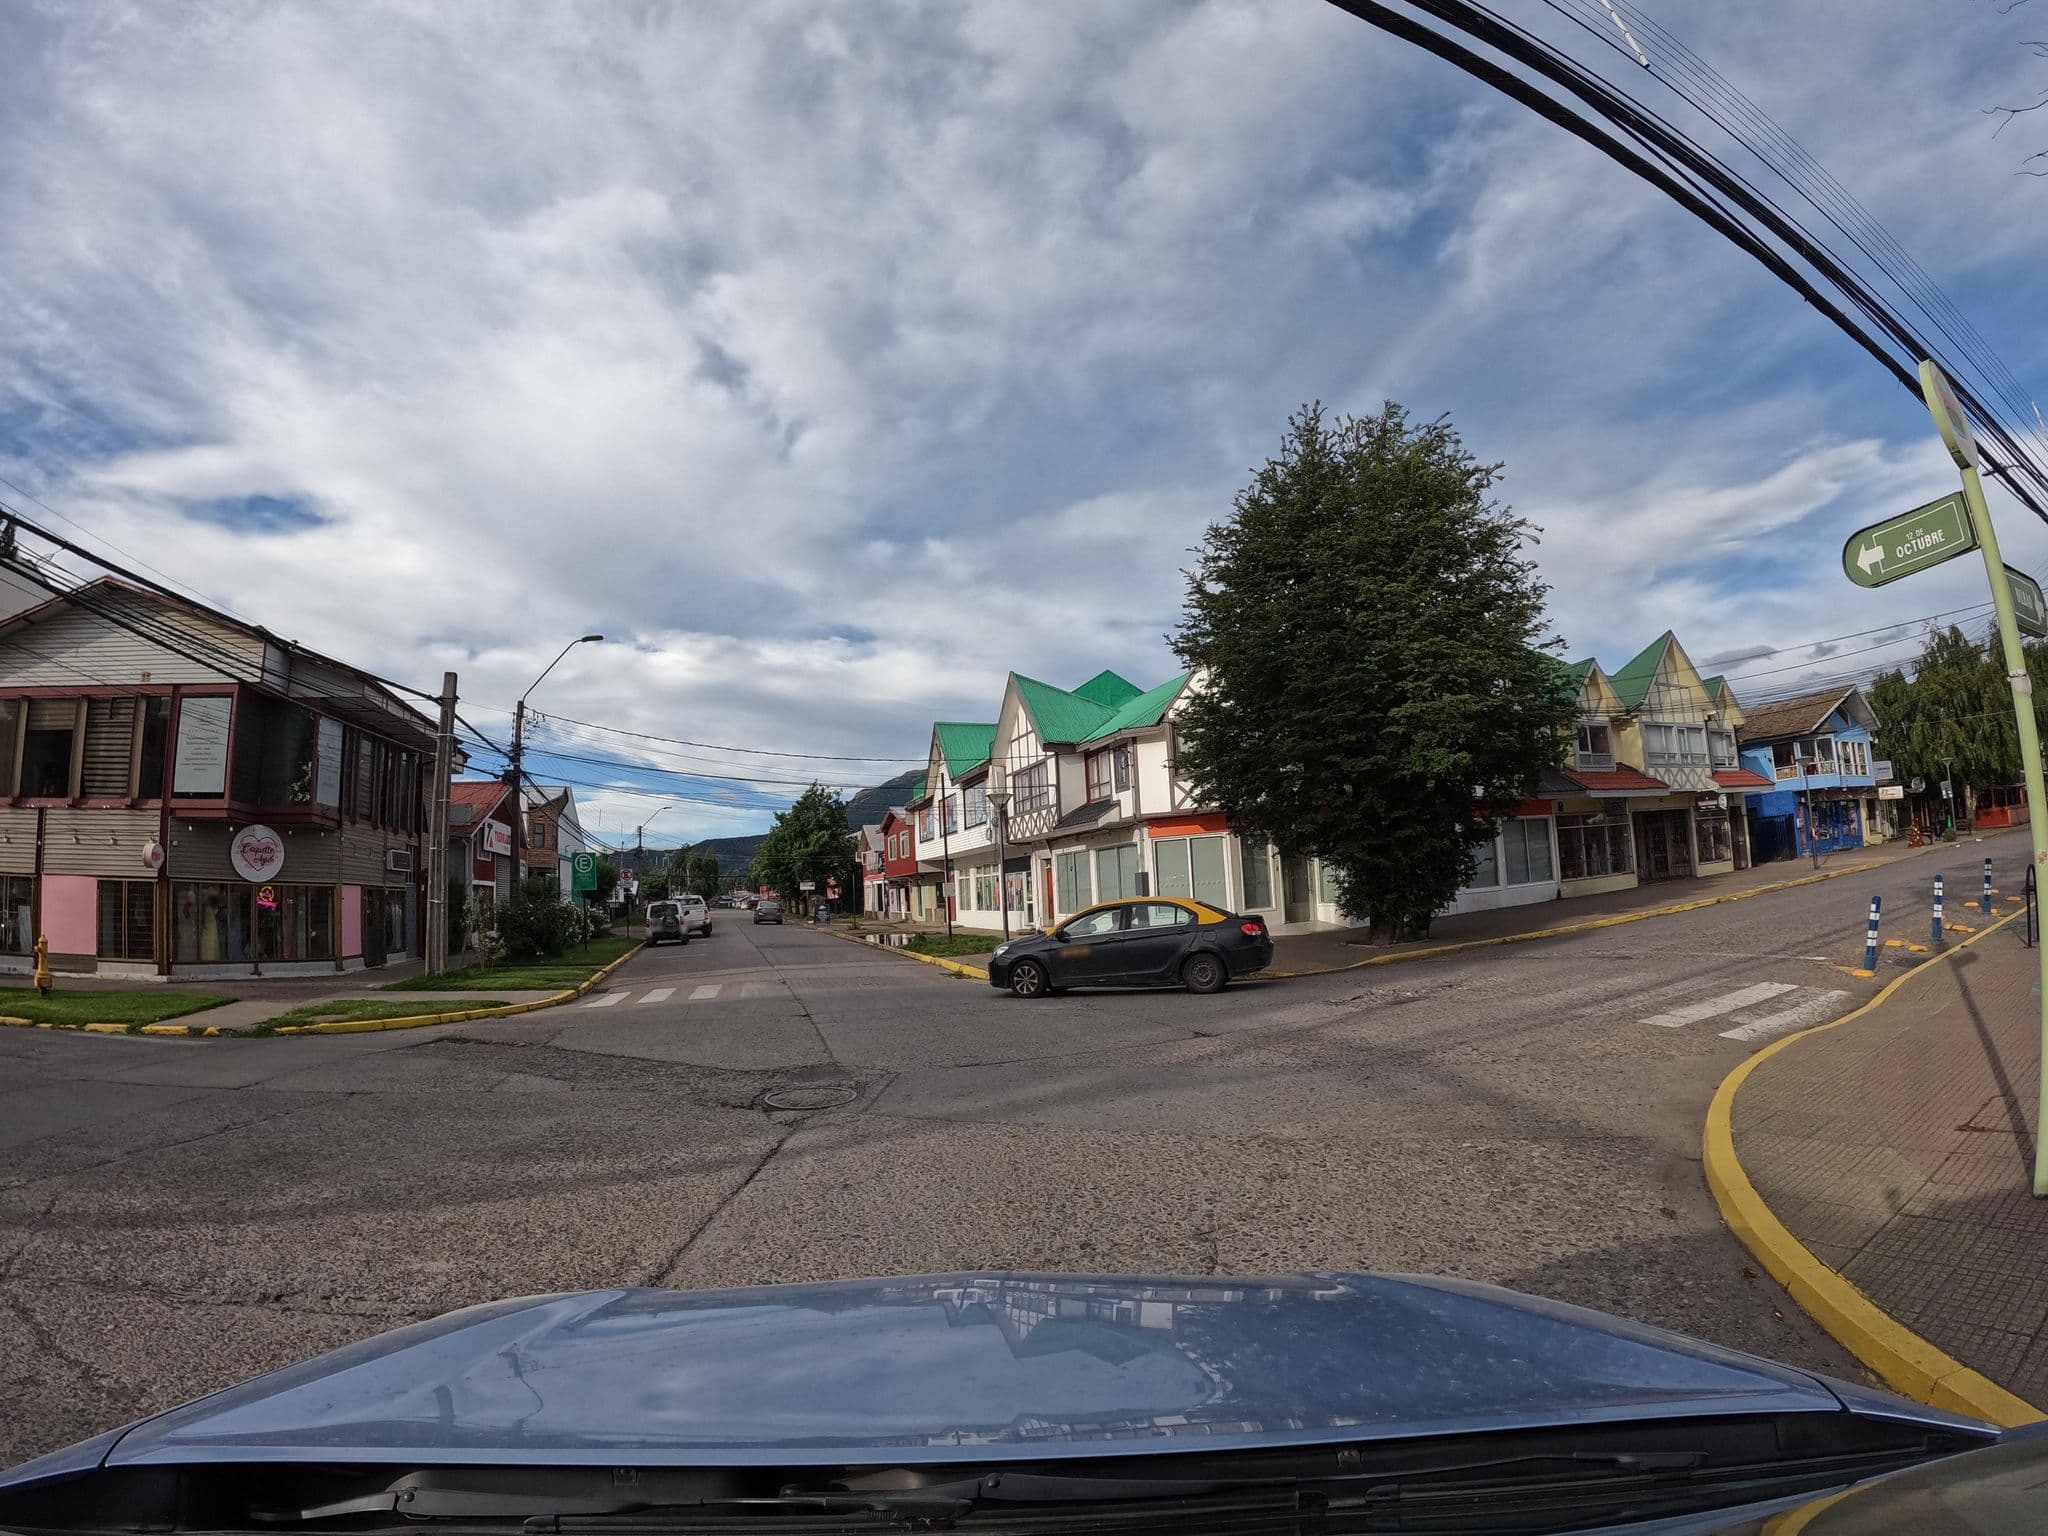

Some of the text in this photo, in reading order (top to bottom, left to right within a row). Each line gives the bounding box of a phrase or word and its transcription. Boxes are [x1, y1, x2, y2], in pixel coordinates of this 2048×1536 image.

[1906, 527, 1925, 541] 12 DE
[1896, 529, 1945, 558] OCTUBRE
[579, 857, 588, 869] E
